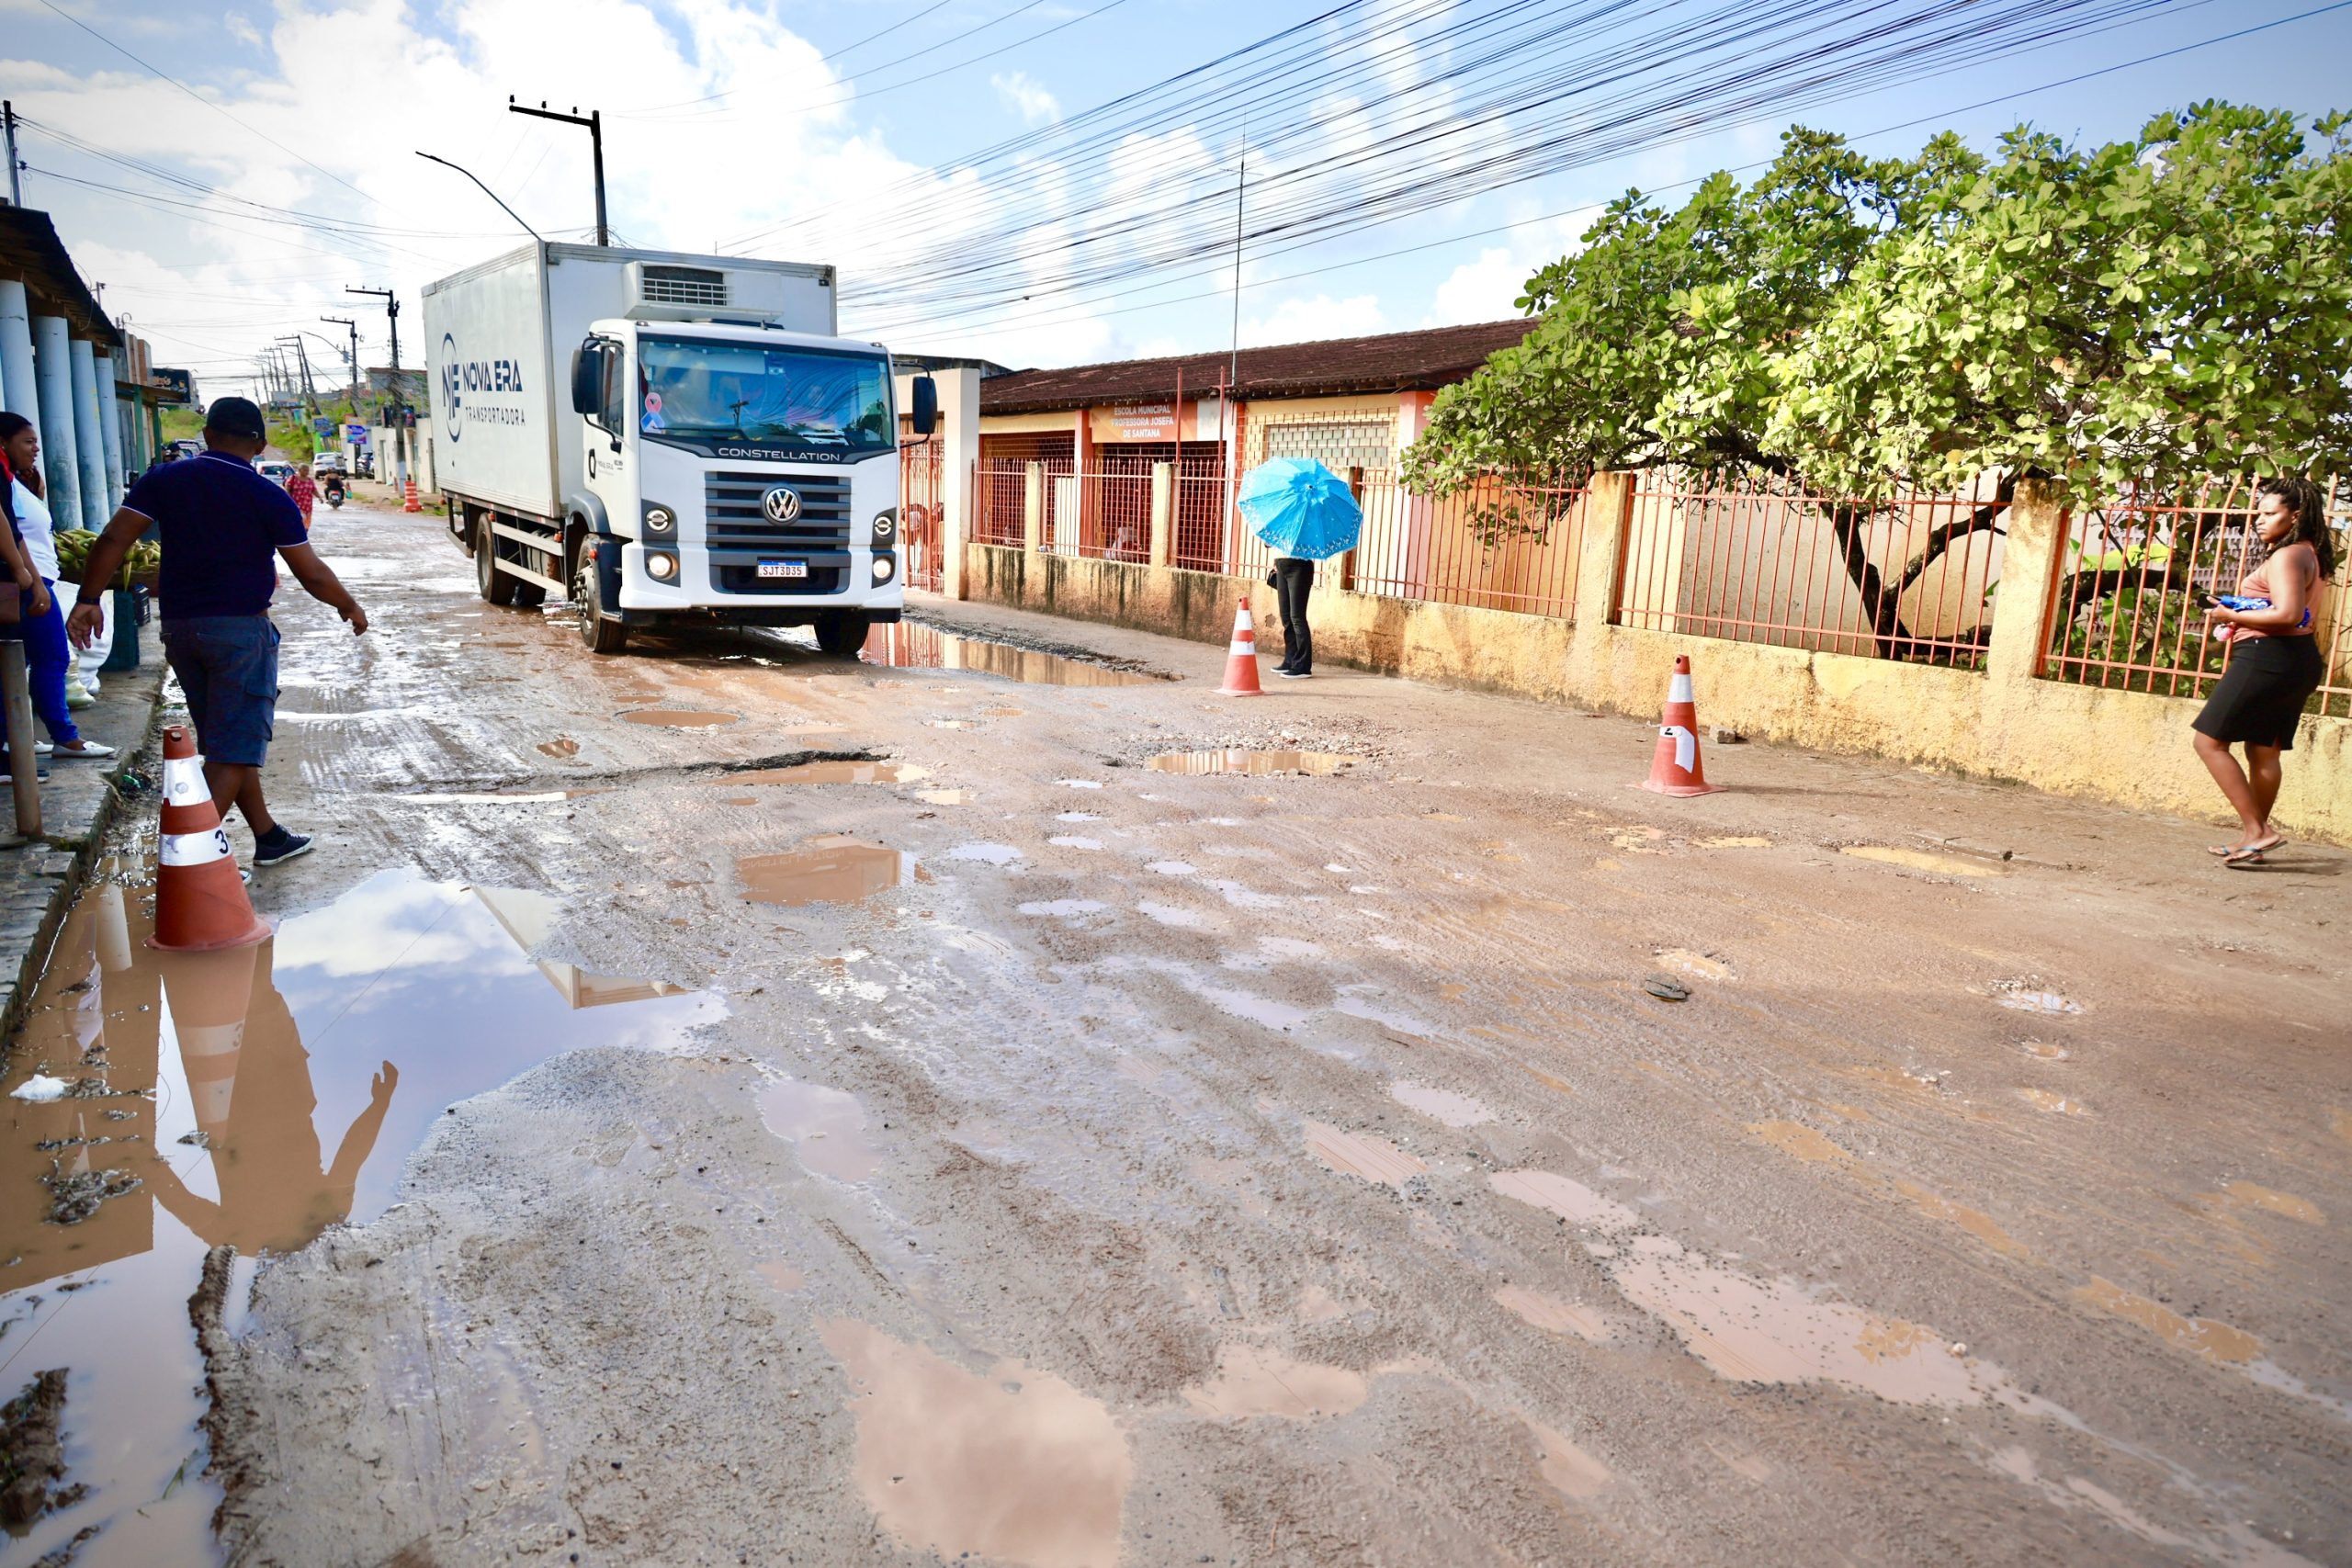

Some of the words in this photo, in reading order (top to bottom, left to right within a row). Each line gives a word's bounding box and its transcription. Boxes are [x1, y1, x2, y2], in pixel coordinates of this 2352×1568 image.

[462, 361, 492, 392] NOVA
[494, 359, 523, 392] ERA
[465, 406, 526, 426] TRANSPORTADORA
[1114, 406, 1137, 416] ESCOLA
[1137, 405, 1170, 415] MUNICIPAL
[1111, 417, 1149, 427] PROFESSORA
[1150, 416, 1174, 425] JOSEFA
[1123, 428, 1131, 438] DE
[1132, 428, 1160, 438] SANTANA
[718, 447, 840, 462] CONSTELLATION
[763, 566, 802, 576] SJT3D35
[215, 829, 229, 854] 3
